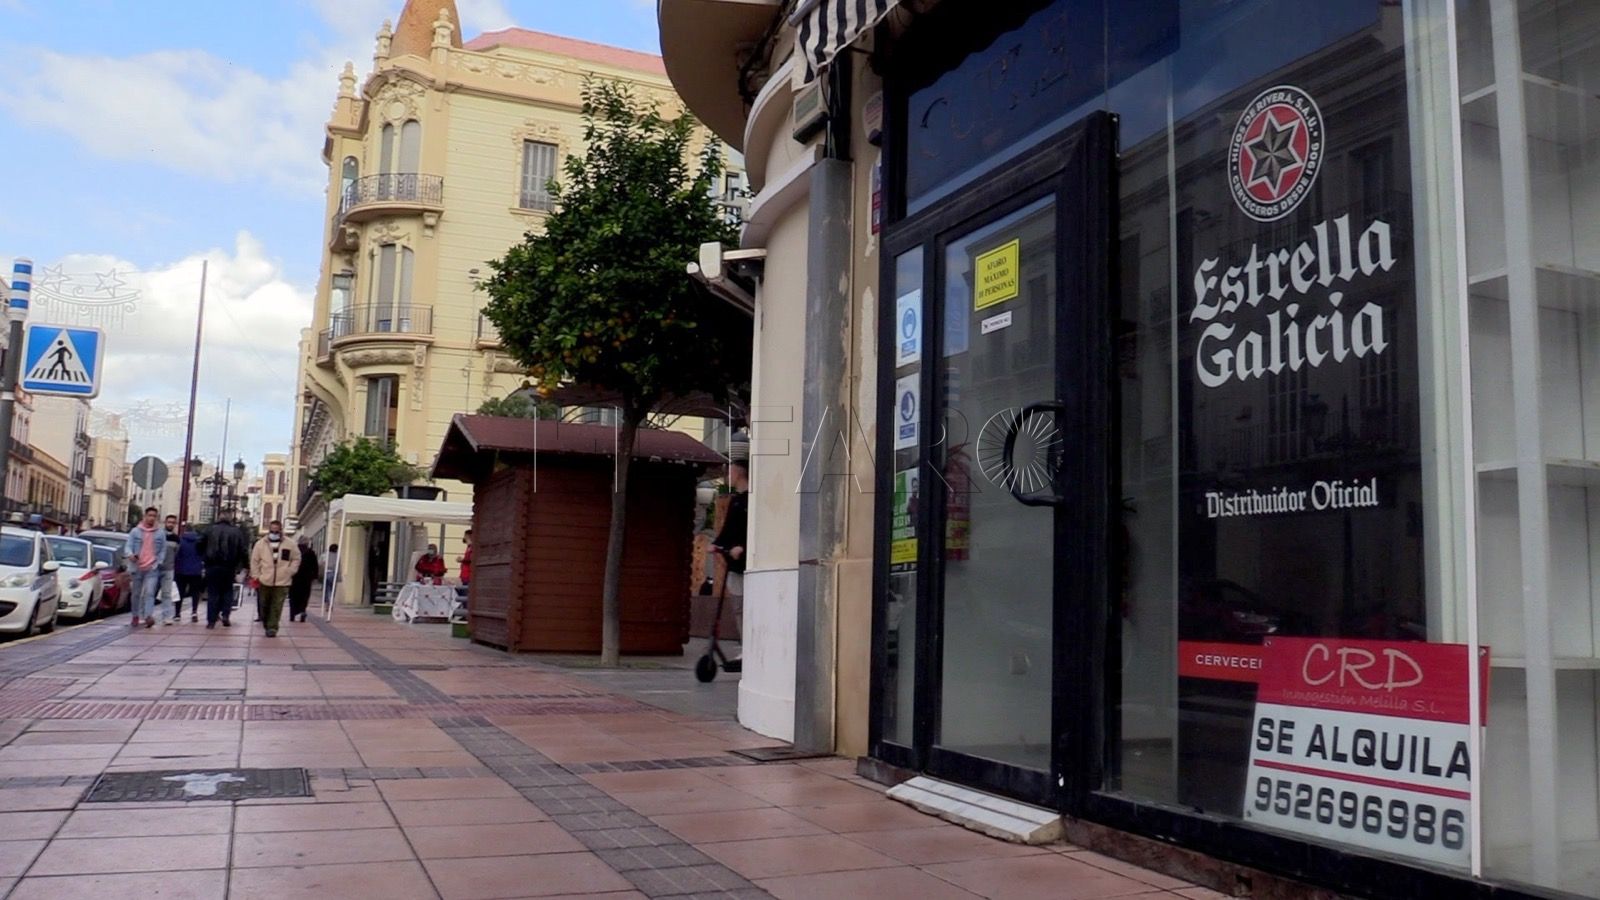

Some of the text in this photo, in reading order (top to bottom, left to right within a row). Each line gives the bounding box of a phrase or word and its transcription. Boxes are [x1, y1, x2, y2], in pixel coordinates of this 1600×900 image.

[1231, 126, 1247, 162] HIJOS
[1243, 107, 1258, 124] DE
[1232, 142, 1320, 216] CERVECEROS DESDE 1906
[1189, 213, 1397, 324] Estrella
[1196, 292, 1389, 388] Galicia
[1205, 477, 1379, 518] Distribuidor Oficial
[1302, 643, 1424, 692] CRD
[1360, 694, 1407, 711] Melilla
[1256, 717, 1471, 781] SE ALQUILA
[1254, 776, 1465, 850] 952696986
